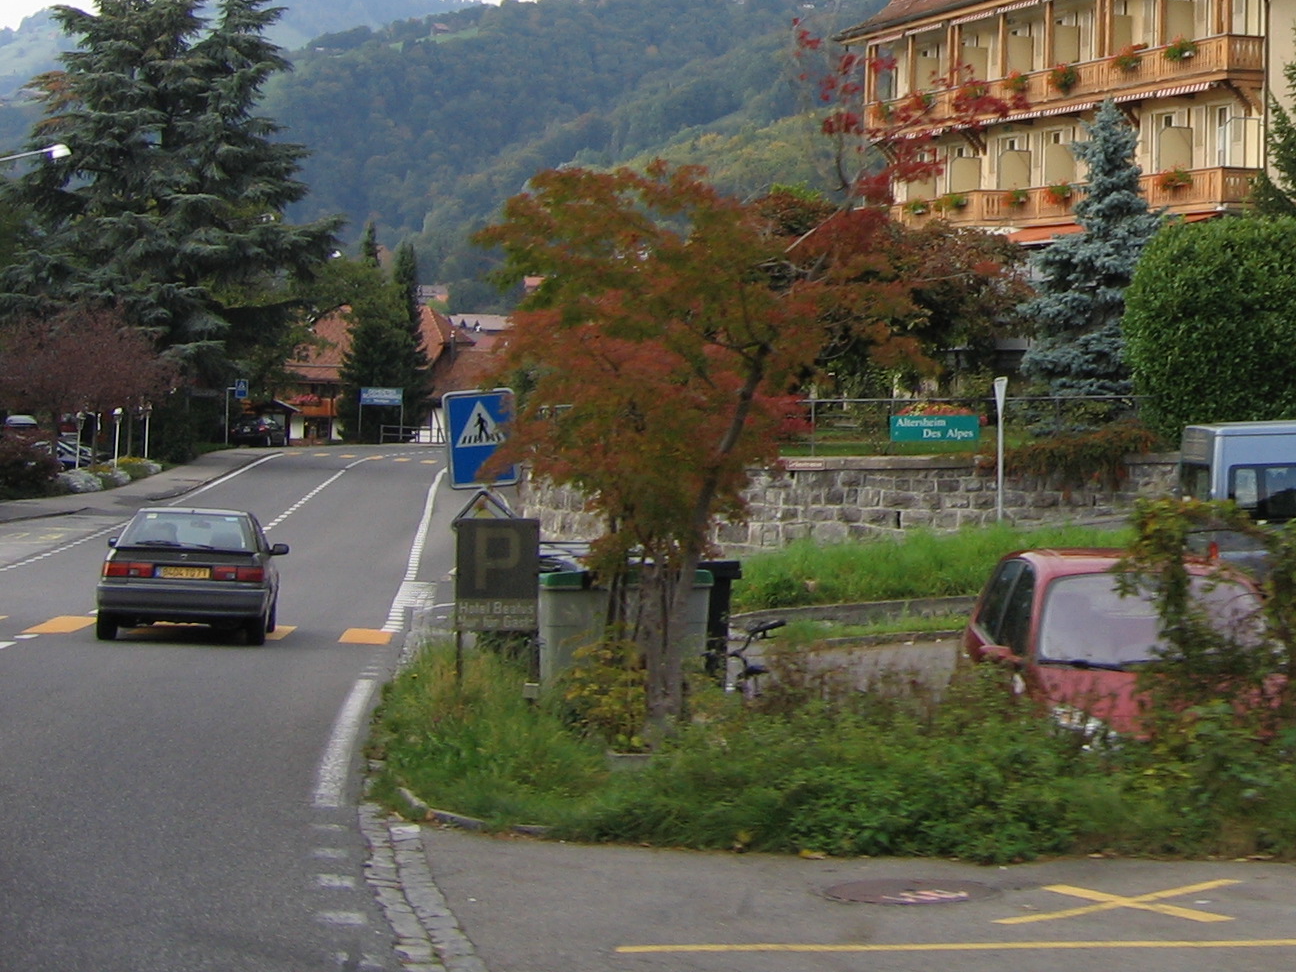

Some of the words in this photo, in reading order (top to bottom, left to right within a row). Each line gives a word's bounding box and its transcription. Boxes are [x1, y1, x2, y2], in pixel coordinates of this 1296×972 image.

[896, 418, 946, 427] Altersheim
[922, 429, 942, 438] Des
[946, 428, 974, 440] Alpes
[475, 527, 521, 589] P
[458, 601, 491, 614] Hotel
